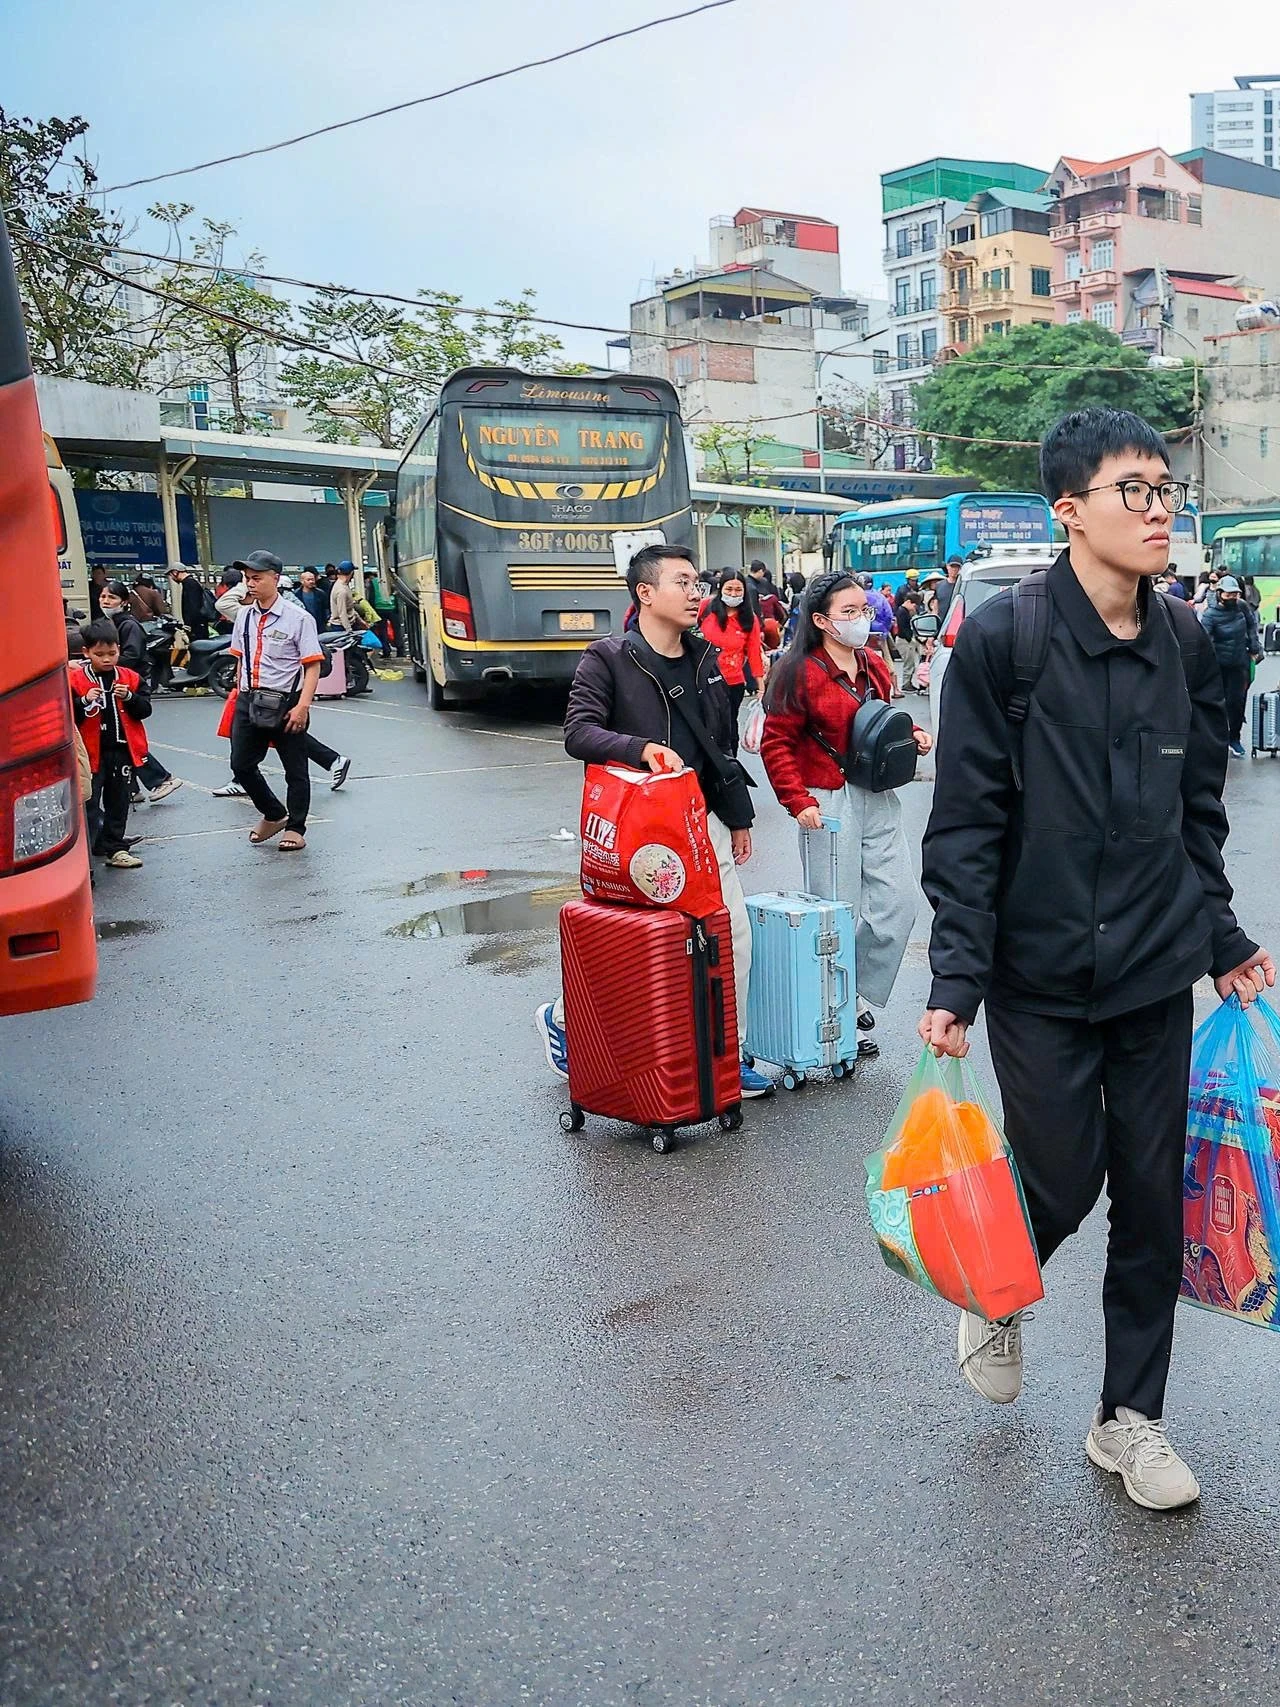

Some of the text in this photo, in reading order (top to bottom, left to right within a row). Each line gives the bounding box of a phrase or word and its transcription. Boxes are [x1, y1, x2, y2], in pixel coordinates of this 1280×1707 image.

[519, 382, 611, 402] Limousine
[578, 429, 645, 450] TRANG
[131, 519, 165, 533] TRƯỜN
[104, 535, 117, 546] XE
[142, 536, 162, 547] TAXI
[596, 878, 631, 893] FASHION
